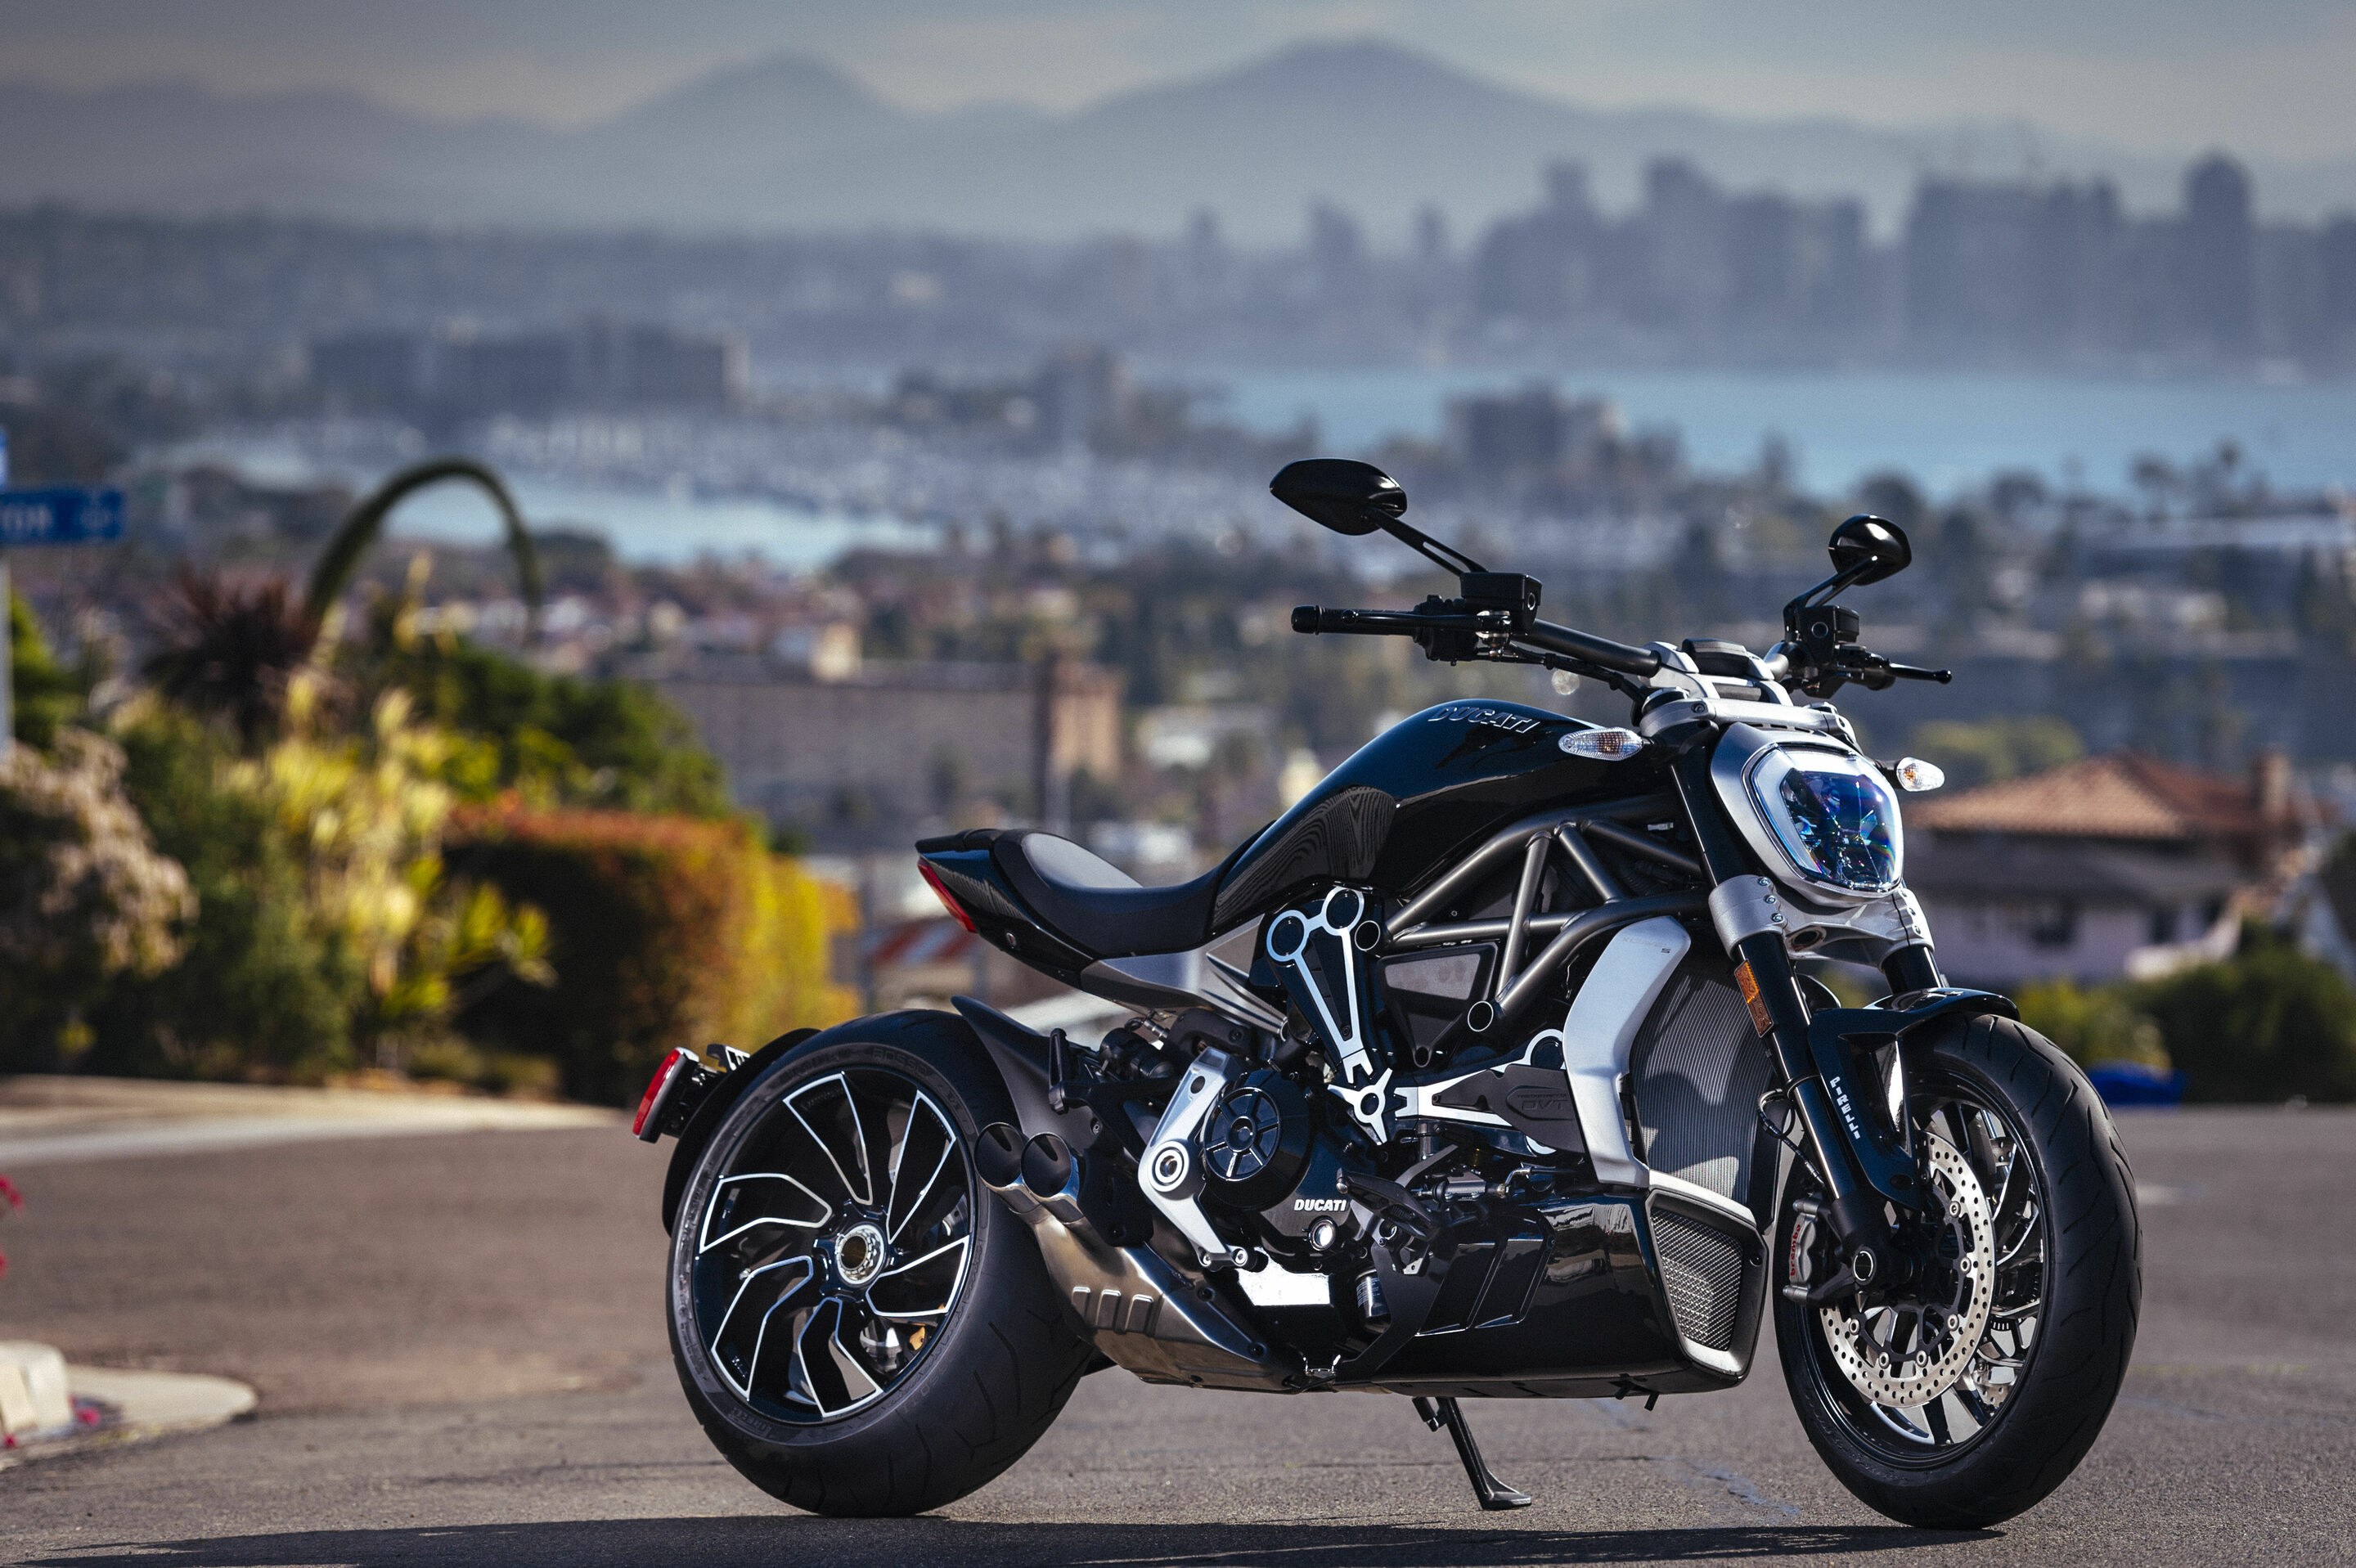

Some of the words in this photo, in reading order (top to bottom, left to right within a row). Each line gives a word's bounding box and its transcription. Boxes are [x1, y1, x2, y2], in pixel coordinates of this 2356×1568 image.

[1428, 706, 1540, 733] DUCATI
[1830, 1076, 1860, 1139] PIRELLI
[1294, 1198, 1347, 1211] DUCATI
[1790, 1224, 1801, 1276] brembo
